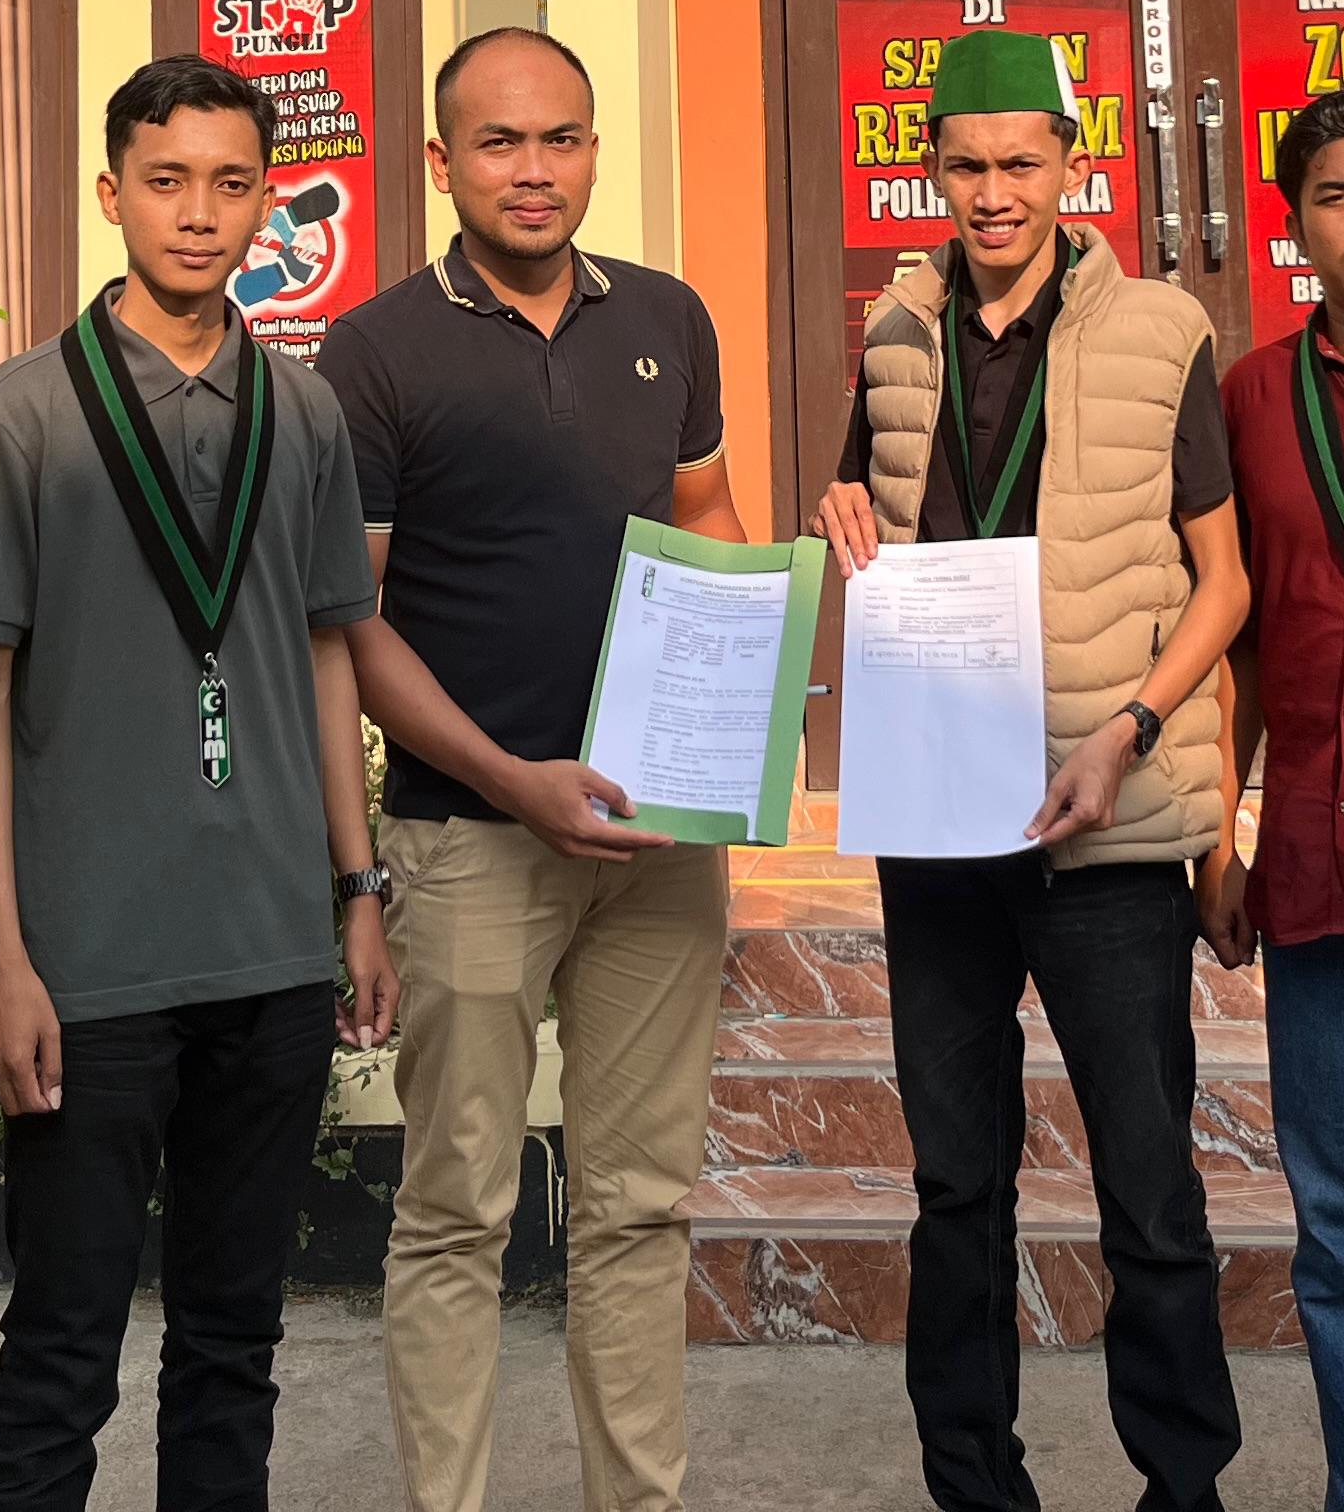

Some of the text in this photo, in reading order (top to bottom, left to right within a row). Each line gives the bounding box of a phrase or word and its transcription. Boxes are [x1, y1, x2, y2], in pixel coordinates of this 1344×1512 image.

[235, 31, 325, 54] PUNGLI
[884, 34, 1087, 88] SAN
[289, 69, 325, 92] DAN
[297, 92, 341, 113] SUAP
[273, 112, 357, 141] AMA KENA
[301, 136, 363, 161] PIDANA
[253, 317, 326, 336] Kami Melayani
[204, 718, 226, 779] HMI
